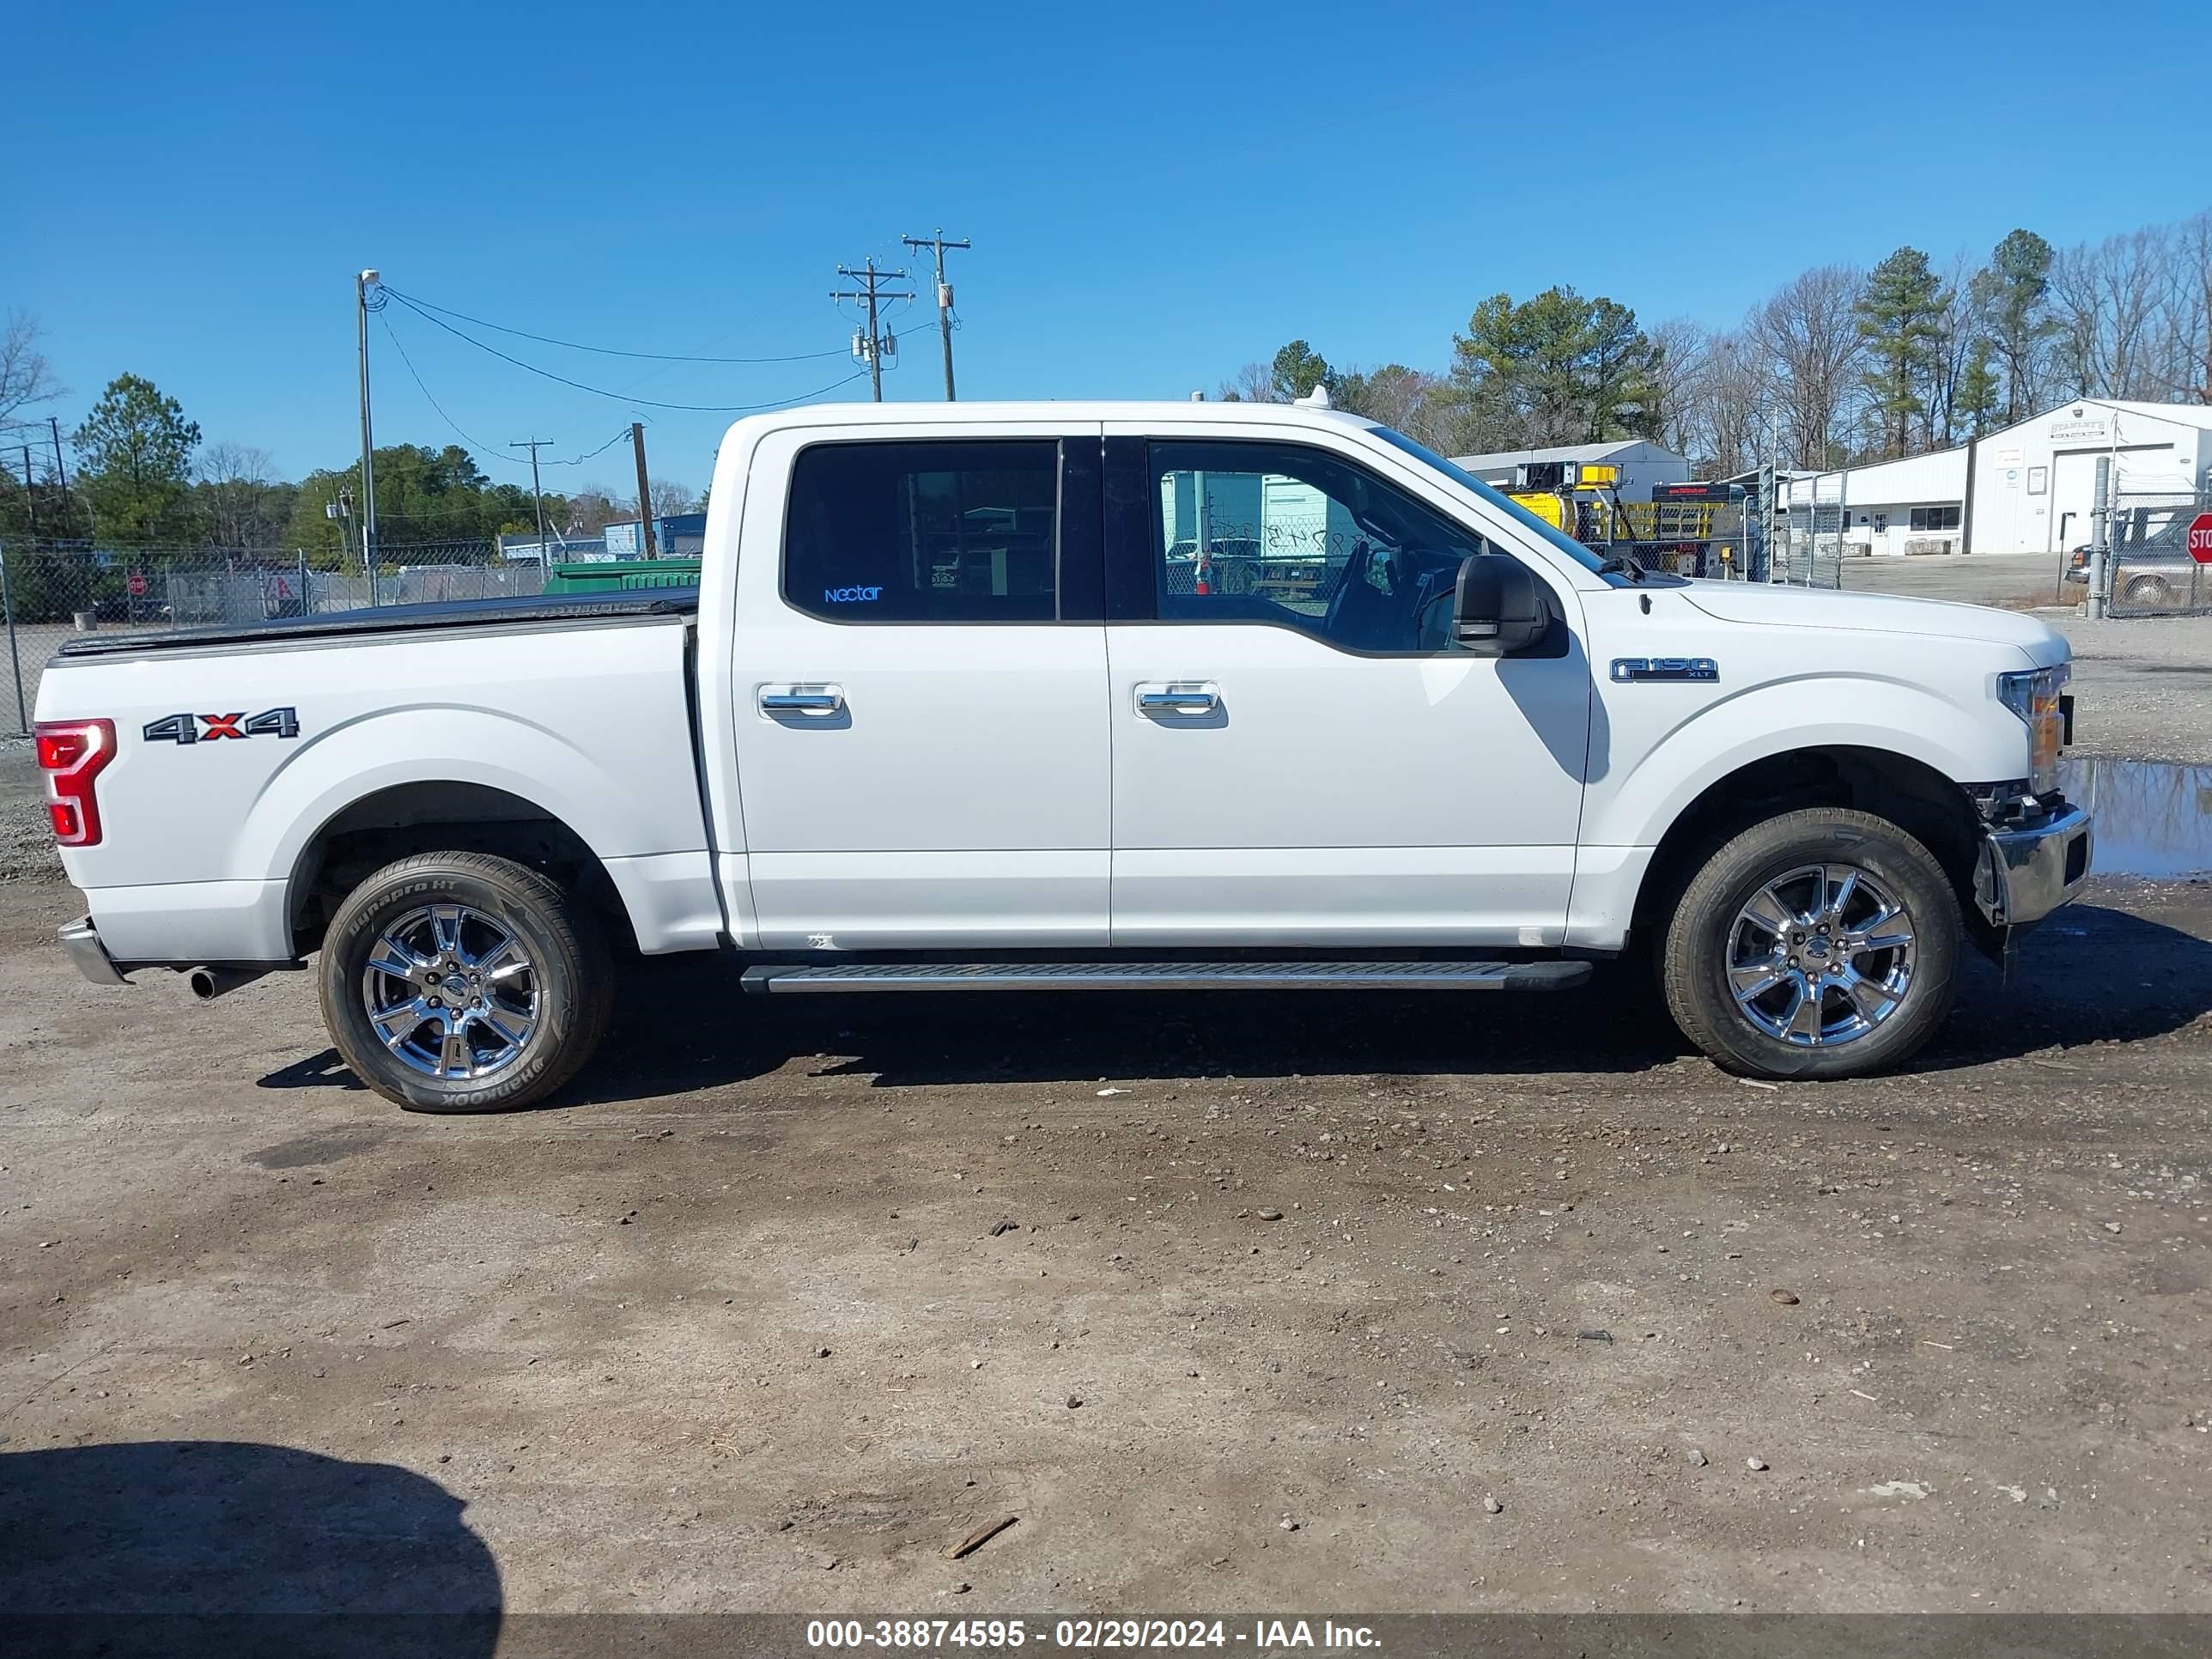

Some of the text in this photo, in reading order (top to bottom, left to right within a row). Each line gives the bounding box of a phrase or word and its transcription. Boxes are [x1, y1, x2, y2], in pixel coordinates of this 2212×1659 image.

[2190, 529, 2212, 550] STO
[129, 580, 146, 591] STOP
[824, 584, 883, 604] Nectar
[431, 880, 459, 890] HT
